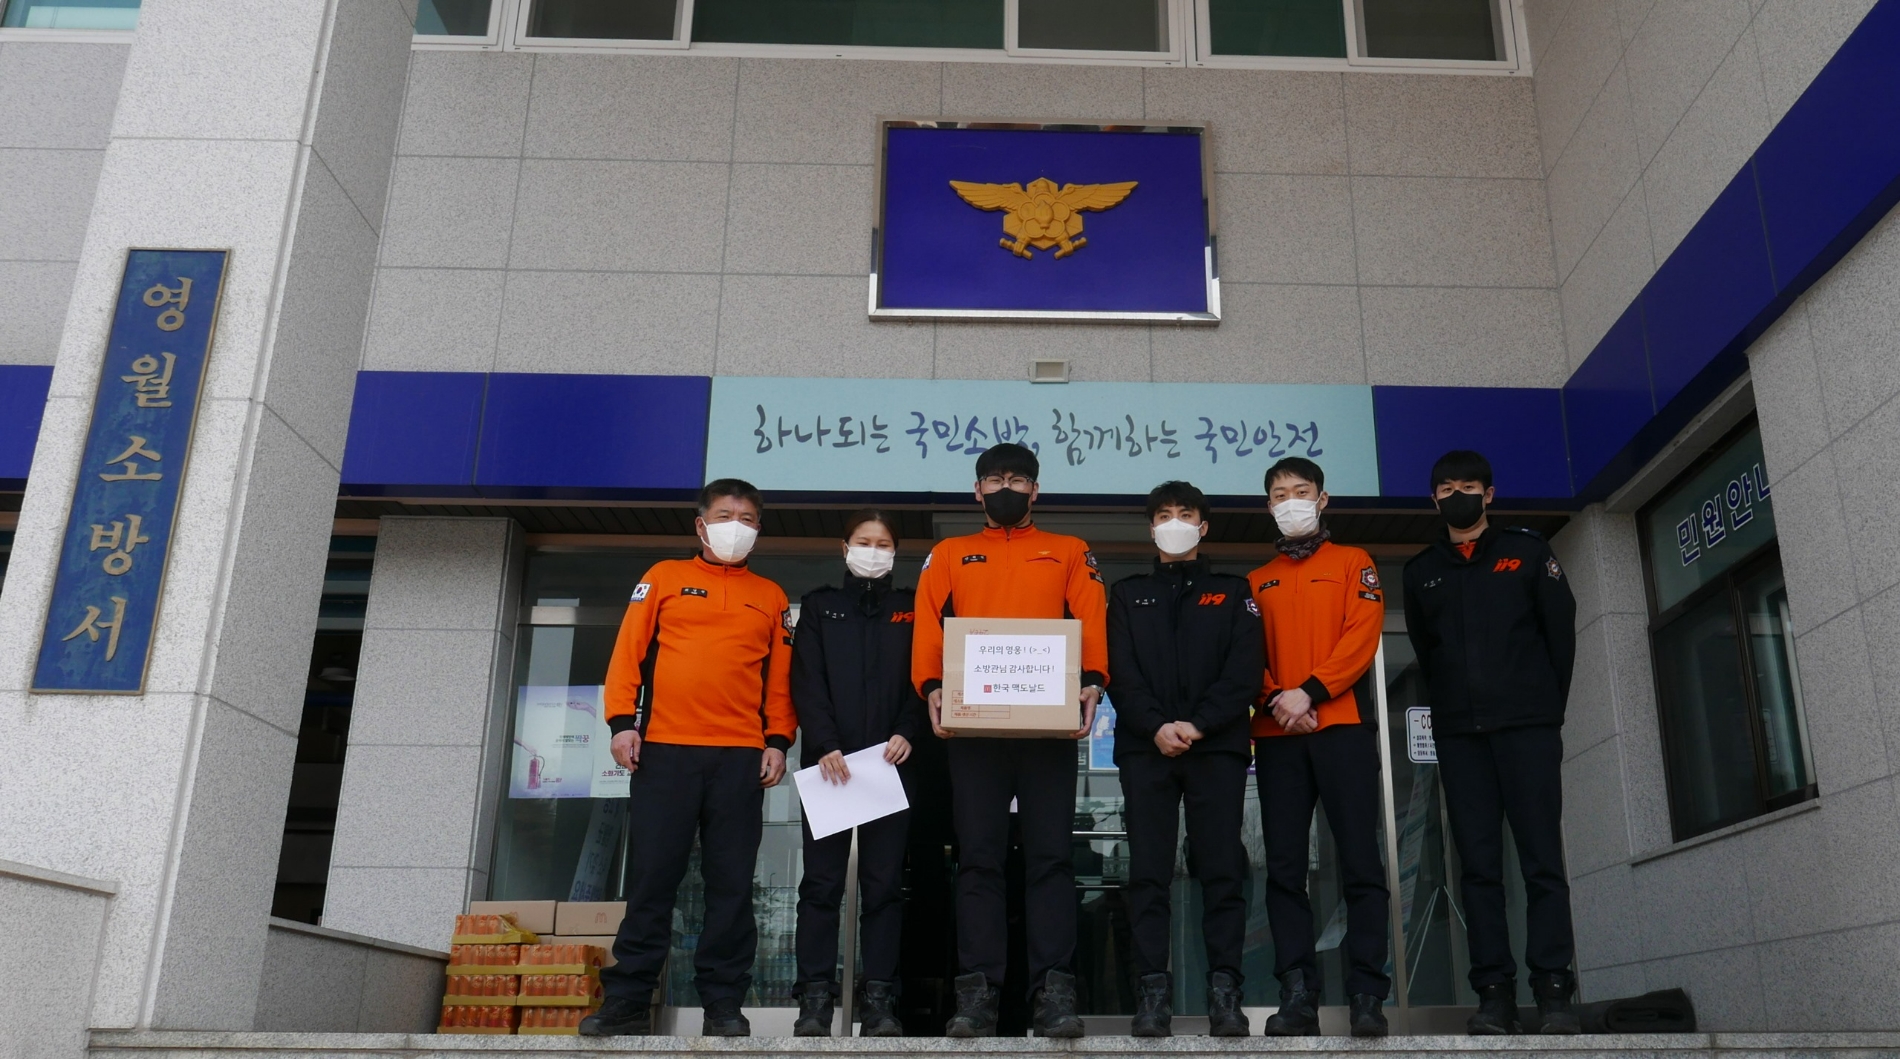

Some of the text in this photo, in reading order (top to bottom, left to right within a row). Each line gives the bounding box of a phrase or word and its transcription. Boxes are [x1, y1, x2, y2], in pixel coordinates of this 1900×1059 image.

[754, 404, 891, 454] 하나되는
[1052, 408, 1181, 466] 함께하는
[1194, 417, 1323, 464] 국민안전
[62, 277, 192, 662] 영월소방서
[1492, 558, 1523, 572] 119
[1198, 593, 1227, 606] 119
[979, 645, 1004, 655] 우리의
[973, 664, 1008, 674] 소방관님
[993, 683, 1046, 693] 한국 맥도날드
